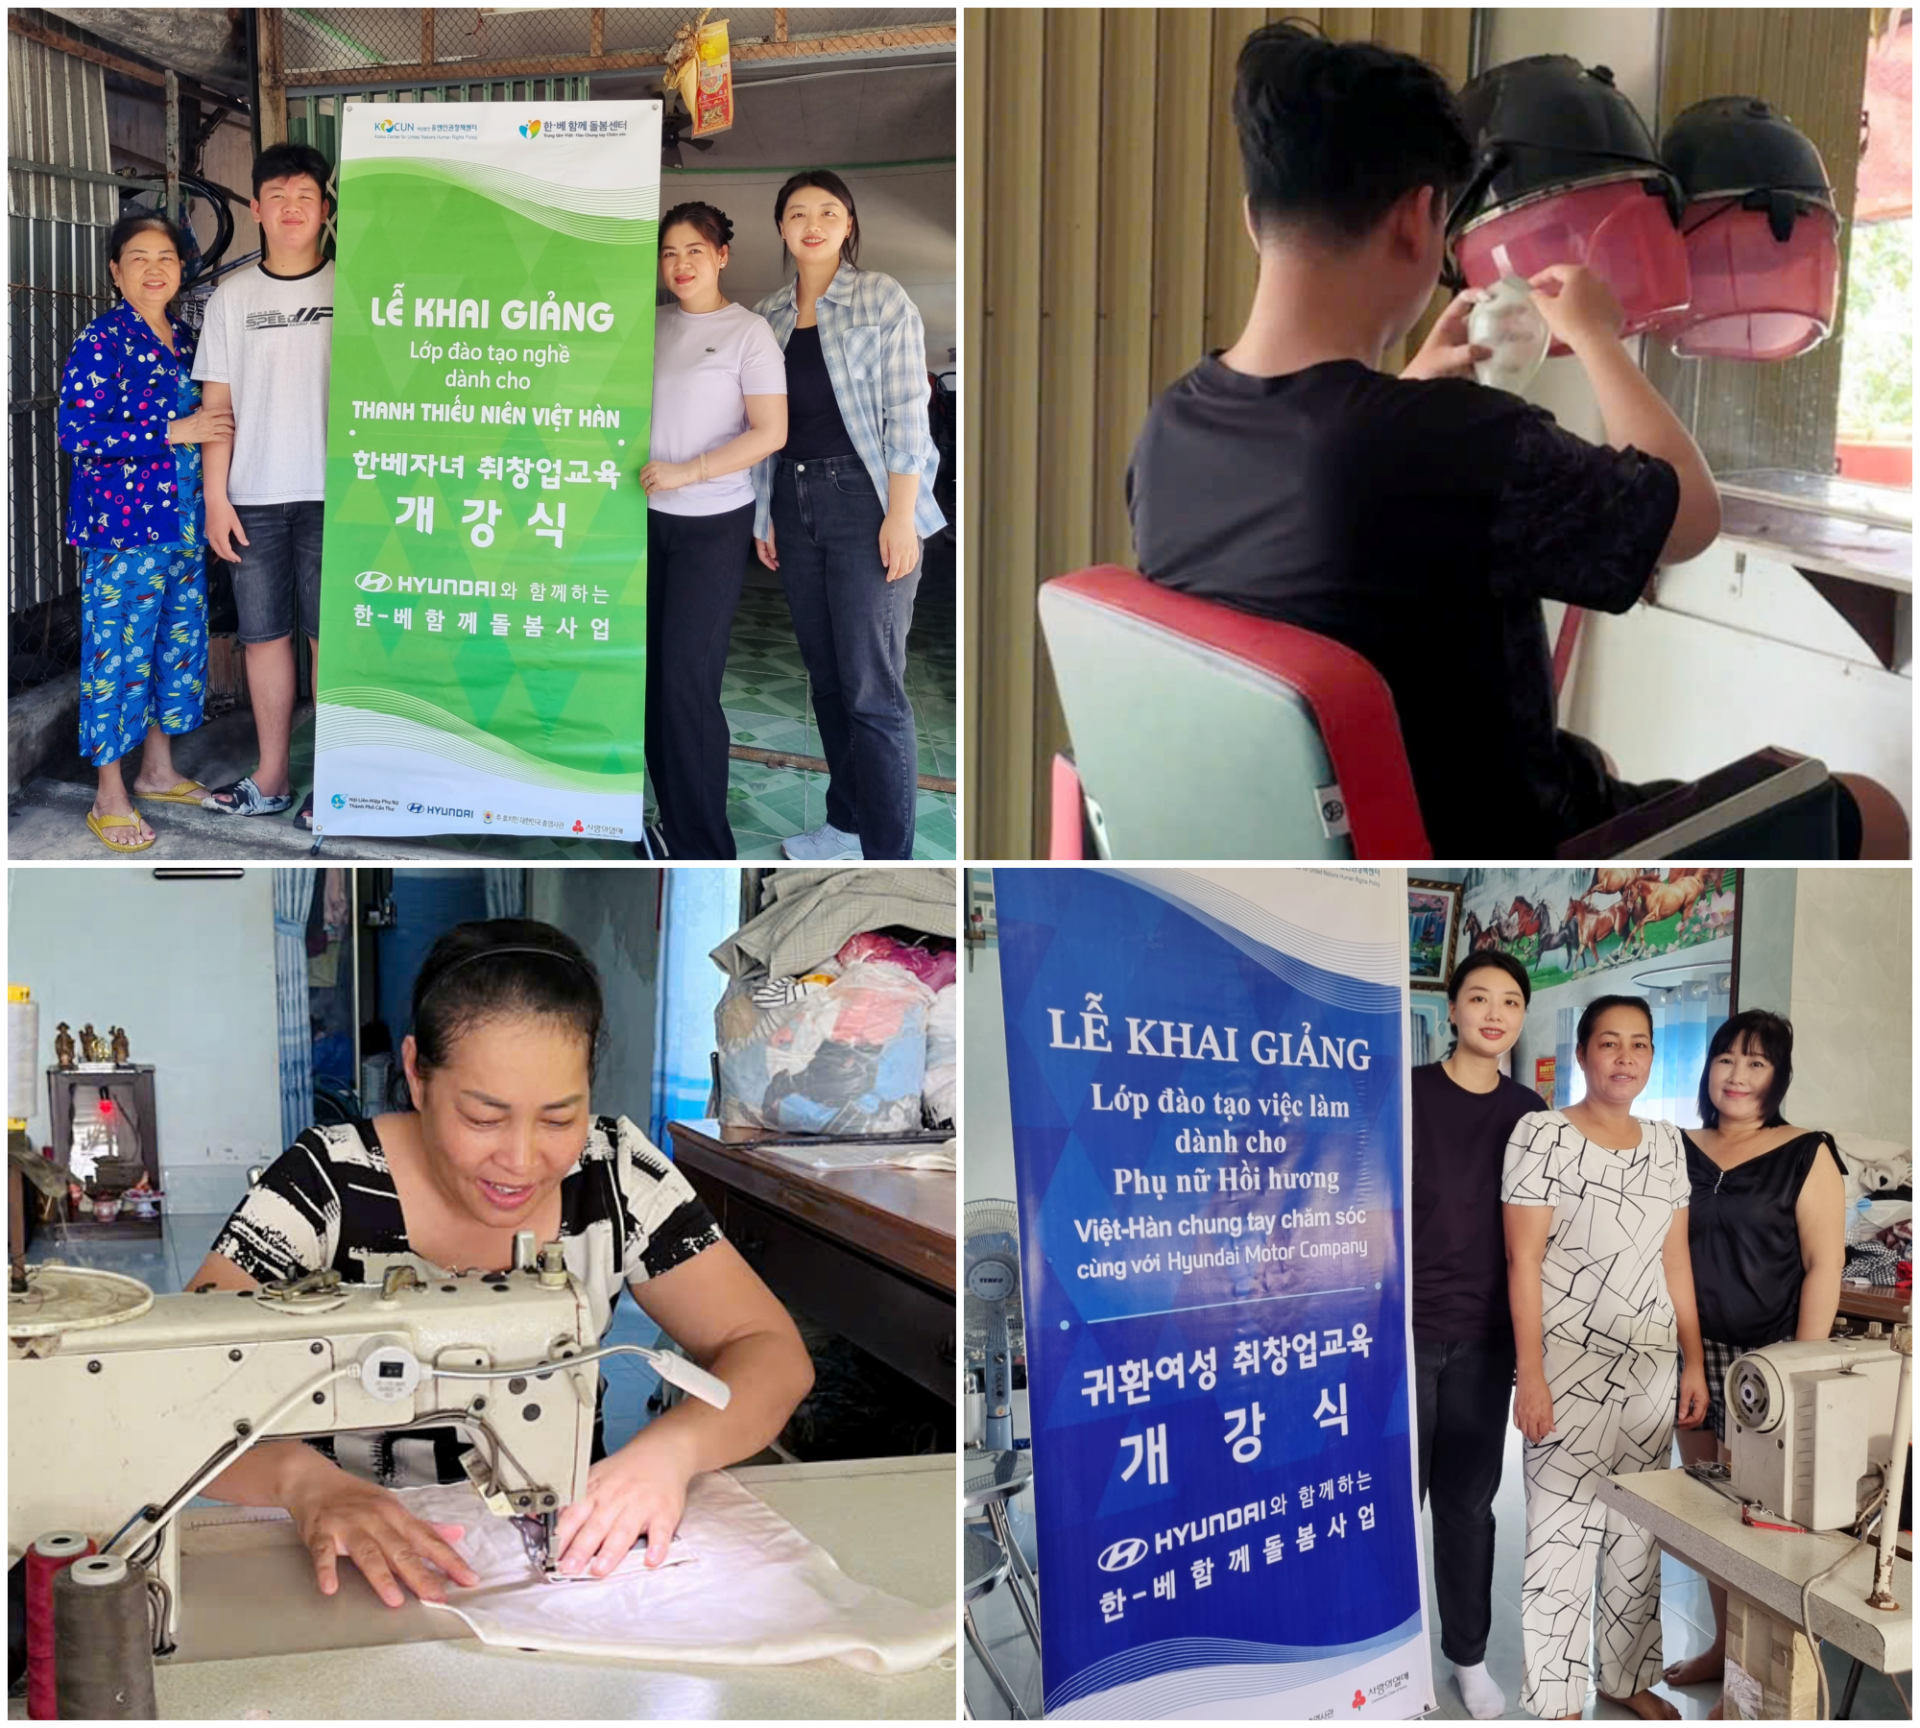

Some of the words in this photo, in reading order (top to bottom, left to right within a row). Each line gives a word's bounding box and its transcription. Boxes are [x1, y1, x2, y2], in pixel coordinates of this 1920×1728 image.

[568, 121, 587, 132] 함께
[589, 120, 627, 132] 돌봄센터
[246, 314, 298, 328] SPEED
[371, 283, 405, 326] LỄ
[415, 298, 489, 329] KHAI
[501, 291, 614, 332] GIẢNG
[410, 341, 443, 363] Lớp
[448, 342, 482, 361] đào
[488, 345, 517, 364] tạo
[523, 344, 570, 368] nghề
[445, 369, 490, 388] dành
[496, 371, 531, 390] cho
[352, 401, 415, 420] THANH
[421, 395, 474, 423] THIẾU
[481, 401, 526, 425] NIÊN
[532, 403, 573, 432] VIỆT
[579, 404, 620, 428] HÀN
[353, 450, 464, 480] 한베자녀
[477, 456, 621, 490] 취창업교육
[529, 582, 609, 604] 함께하는
[427, 806, 474, 819] HYUNDAI
[586, 823, 624, 835] 사랑의열매
[1047, 992, 1112, 1053] LỄ
[1126, 1017, 1239, 1063] KHAI
[1251, 1023, 1371, 1071] GIẢNG
[1091, 1083, 1149, 1119] Lớp
[1157, 1088, 1205, 1115] đào
[1213, 1092, 1250, 1122] tạo
[1258, 1092, 1303, 1123] việc
[1310, 1094, 1349, 1118] làm
[1175, 1127, 1238, 1153] dành
[1245, 1131, 1287, 1153] cho
[1114, 1168, 1167, 1200] Phụ
[1176, 1168, 1211, 1193] nữ
[1218, 1160, 1261, 1192] Hồi
[1268, 1167, 1340, 1194] hương
[1074, 1215, 1172, 1247] Việt-Hàn
[1178, 1211, 1242, 1237] chung
[1247, 1212, 1276, 1235] tay
[1281, 1208, 1331, 1230] chăm
[1335, 1206, 1367, 1225] sóc
[1077, 1257, 1127, 1280] cùng
[1131, 1252, 1161, 1274] với
[1168, 1246, 1240, 1275] Hyundai
[1245, 1243, 1295, 1264] Motor
[1299, 1238, 1368, 1260] Company
[1081, 1347, 1217, 1407] 귀환여성
[1232, 1323, 1373, 1376] 취창업교육
[1298, 1470, 1372, 1509] 함께하는
[1368, 1671, 1409, 1696] 사랑의열매
